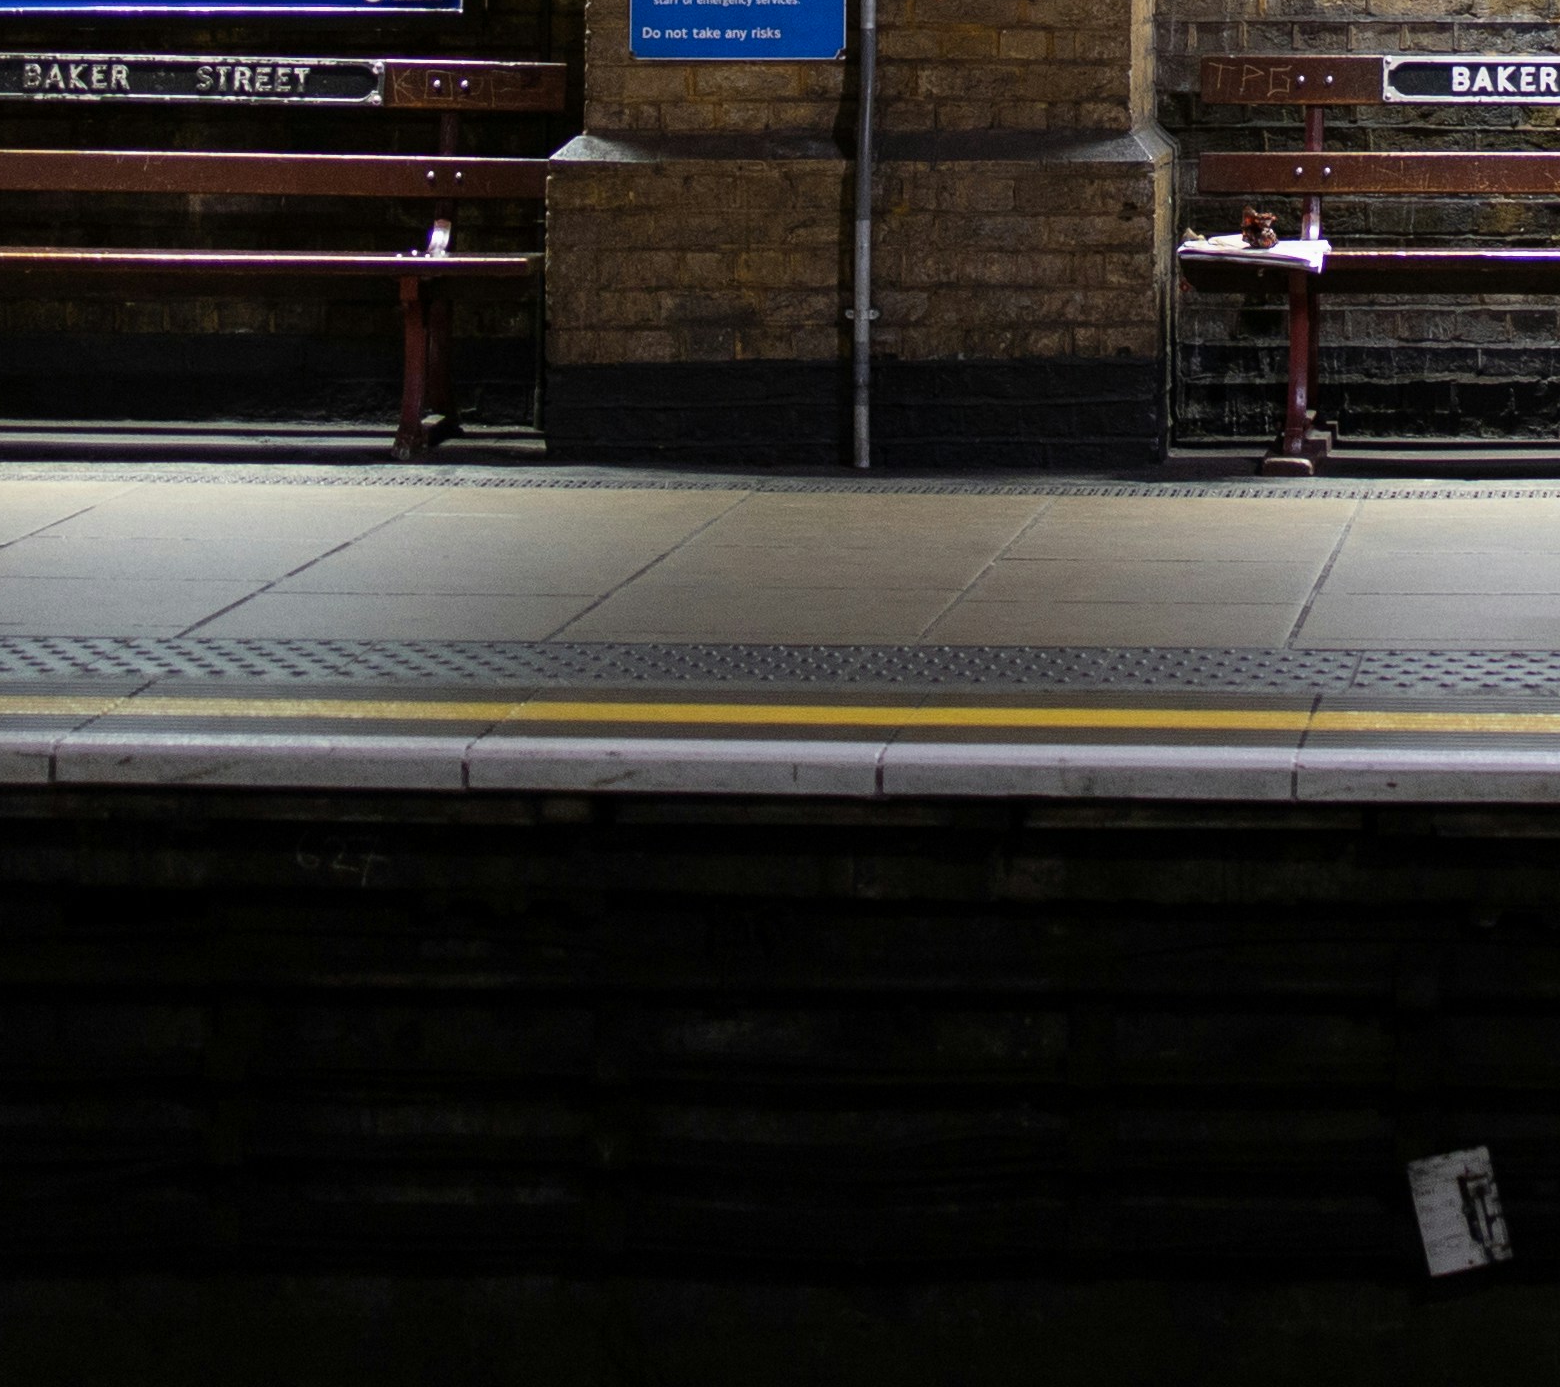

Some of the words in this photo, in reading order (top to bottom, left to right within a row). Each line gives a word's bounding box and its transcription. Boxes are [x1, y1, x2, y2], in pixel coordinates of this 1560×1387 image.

[643, 27, 661, 38] Do
[666, 28, 687, 39] not
[693, 27, 721, 38] take
[725, 29, 747, 40] any
[752, 27, 781, 38] risks
[23, 63, 130, 90] BAKER
[196, 66, 310, 93] STREET
[1452, 66, 1559, 92] BAKER
